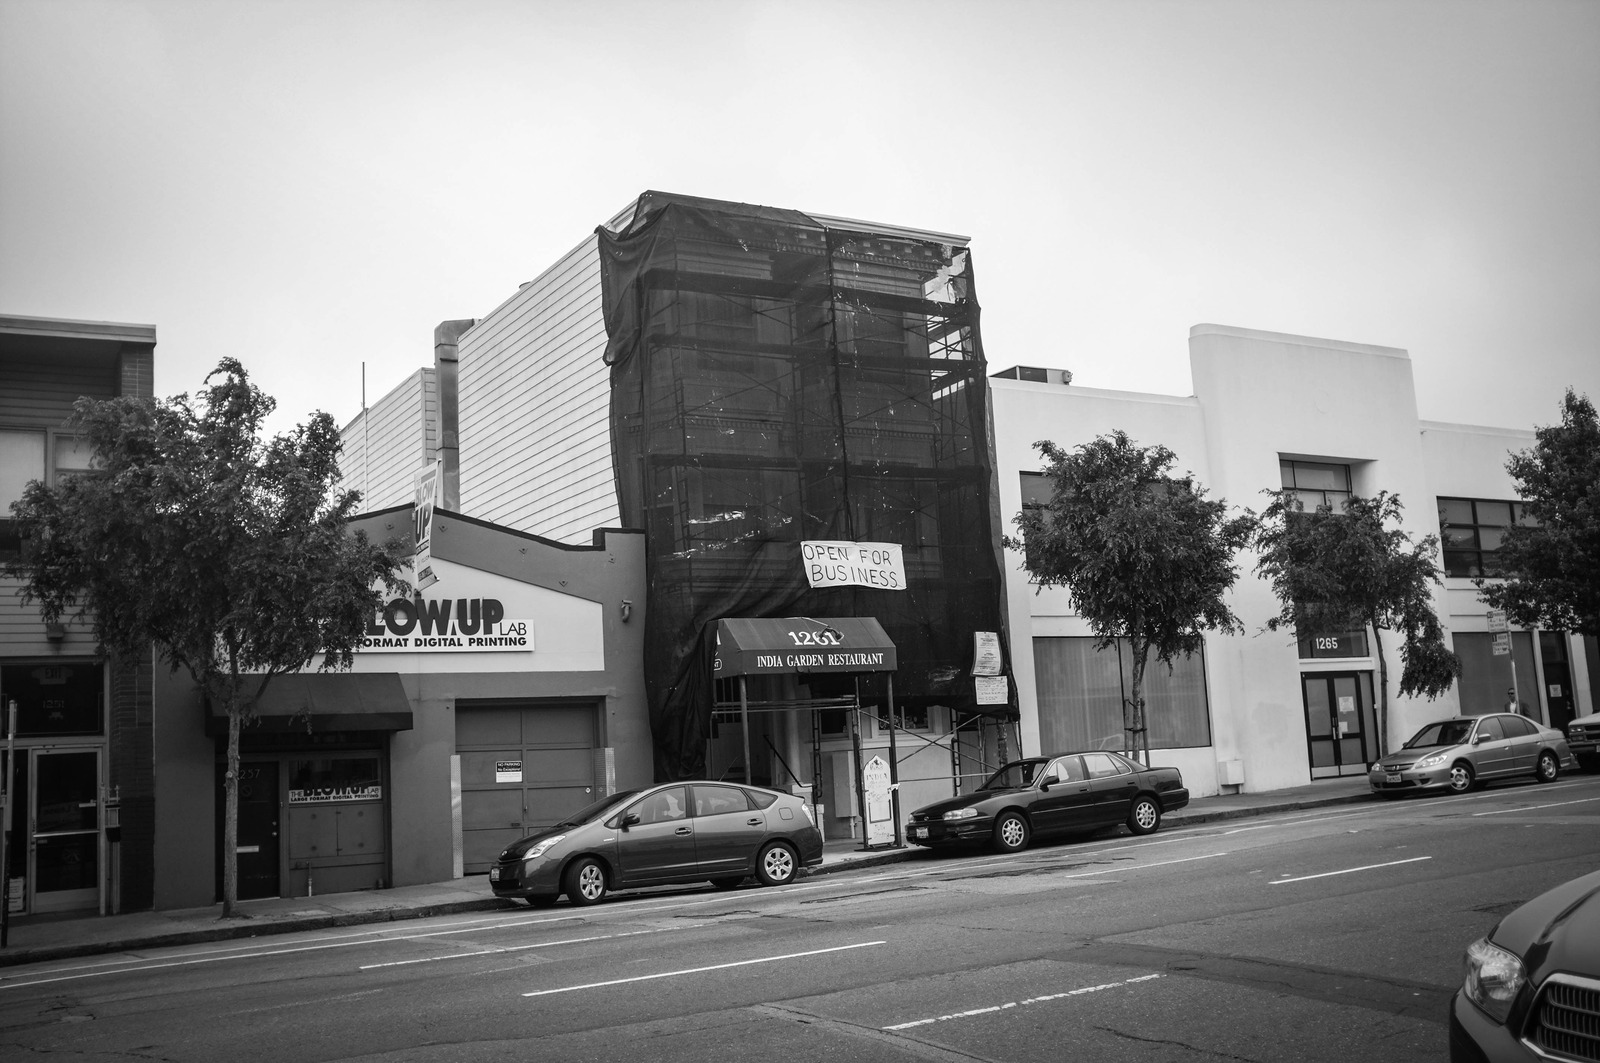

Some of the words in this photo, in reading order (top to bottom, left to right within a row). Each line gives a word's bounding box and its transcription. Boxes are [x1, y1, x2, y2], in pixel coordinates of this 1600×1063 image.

[803, 544, 849, 561] OPEN
[859, 549, 892, 566] FOR
[811, 564, 898, 588] BUSINESS
[500, 622, 527, 636] LAB
[361, 638, 409, 648] ORMAT
[414, 637, 463, 648] DIGITAL
[468, 637, 527, 647] PRINTING
[788, 630, 840, 646] 1261
[1315, 637, 1338, 649] 1265
[757, 655, 783, 667] INDIA
[787, 654, 824, 667] GARDEN
[828, 653, 884, 666] RESTAURANT
